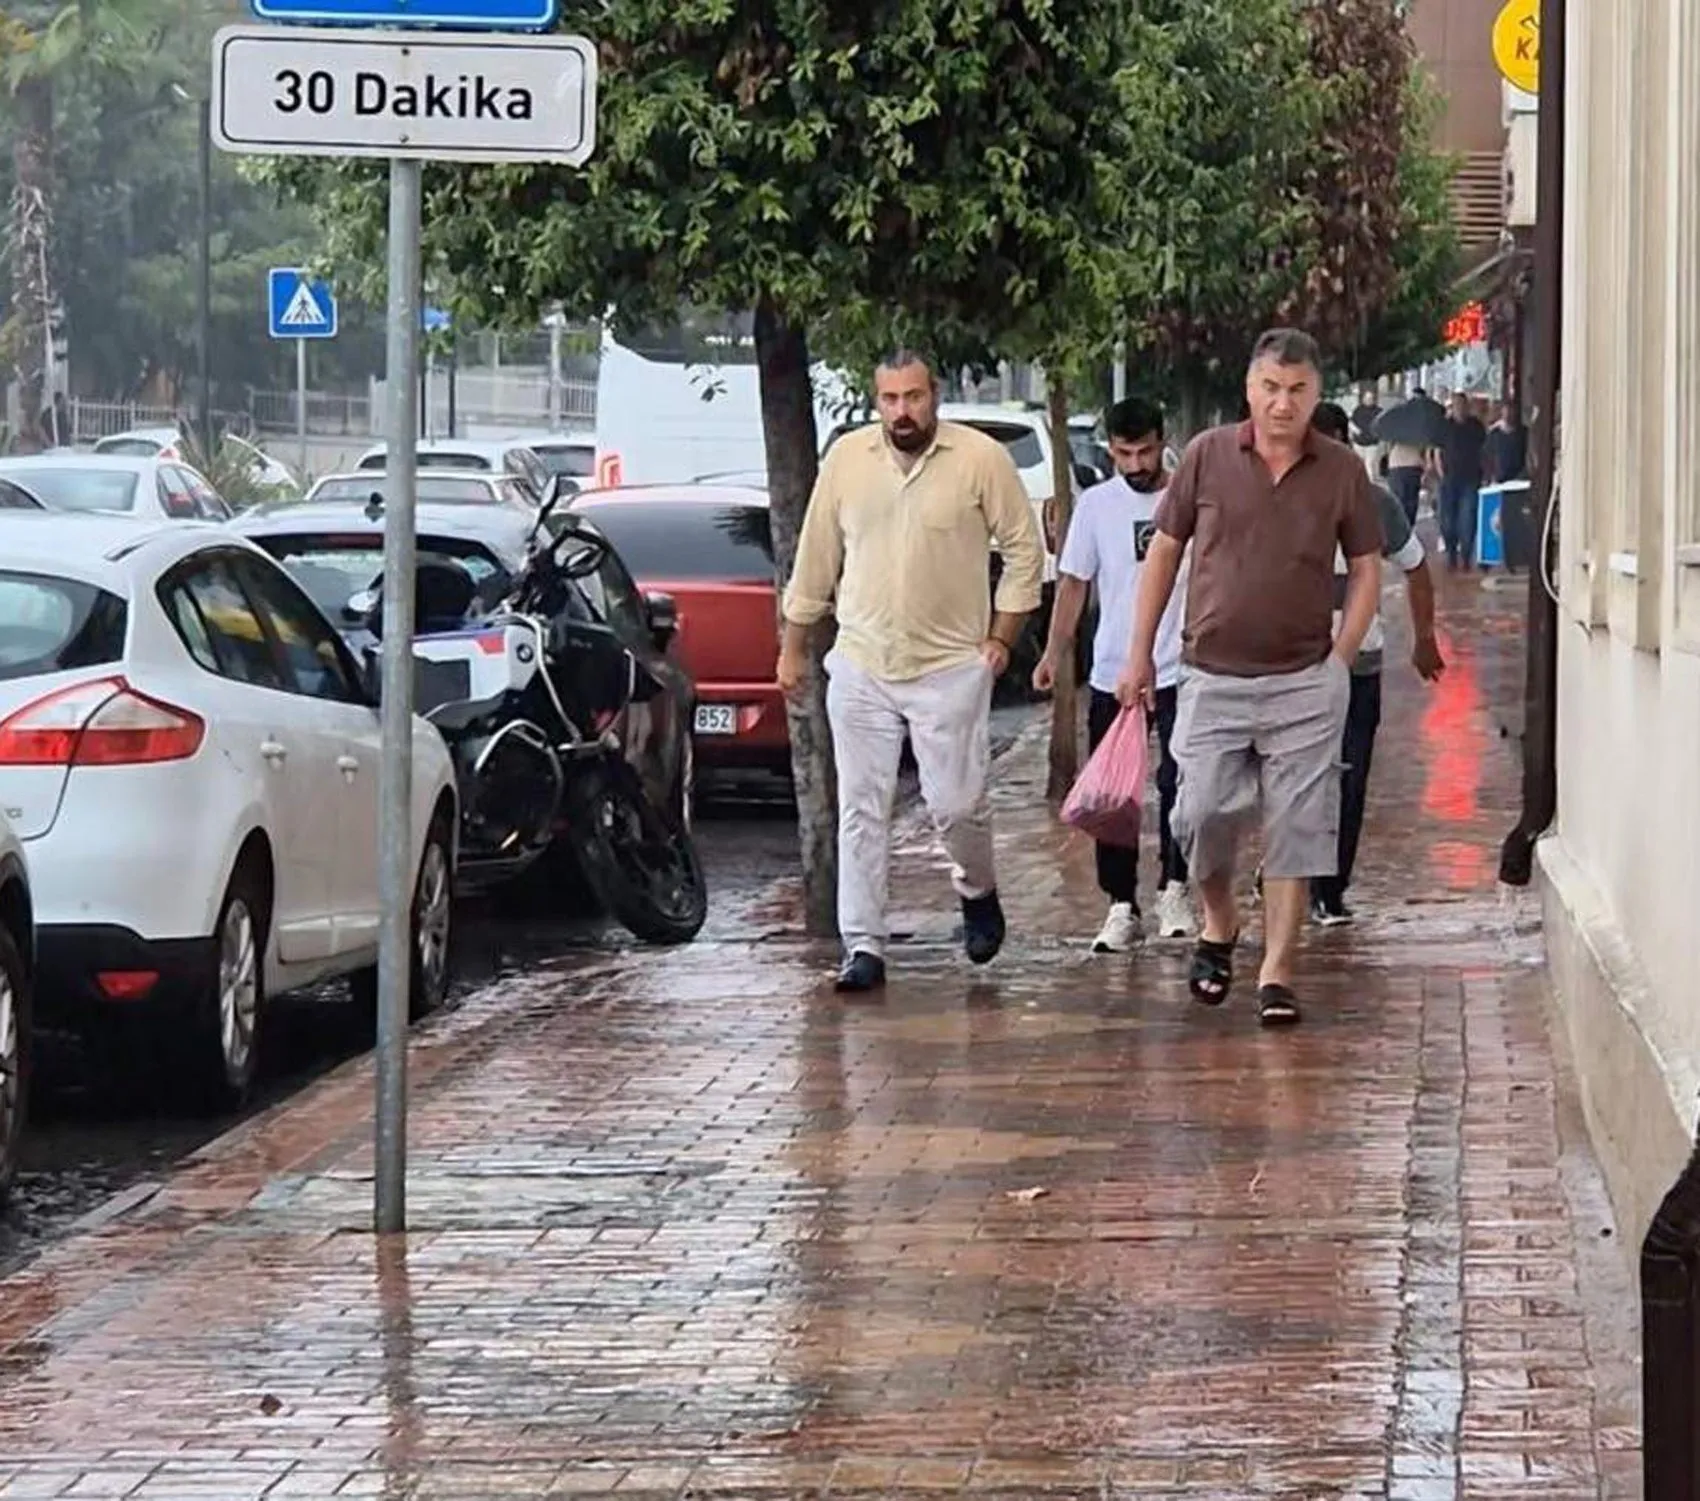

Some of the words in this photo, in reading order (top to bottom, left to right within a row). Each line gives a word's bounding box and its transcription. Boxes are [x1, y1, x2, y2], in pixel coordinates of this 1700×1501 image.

[275, 69, 334, 114] 30
[355, 72, 532, 120] Dakika
[698, 708, 730, 728] 852
